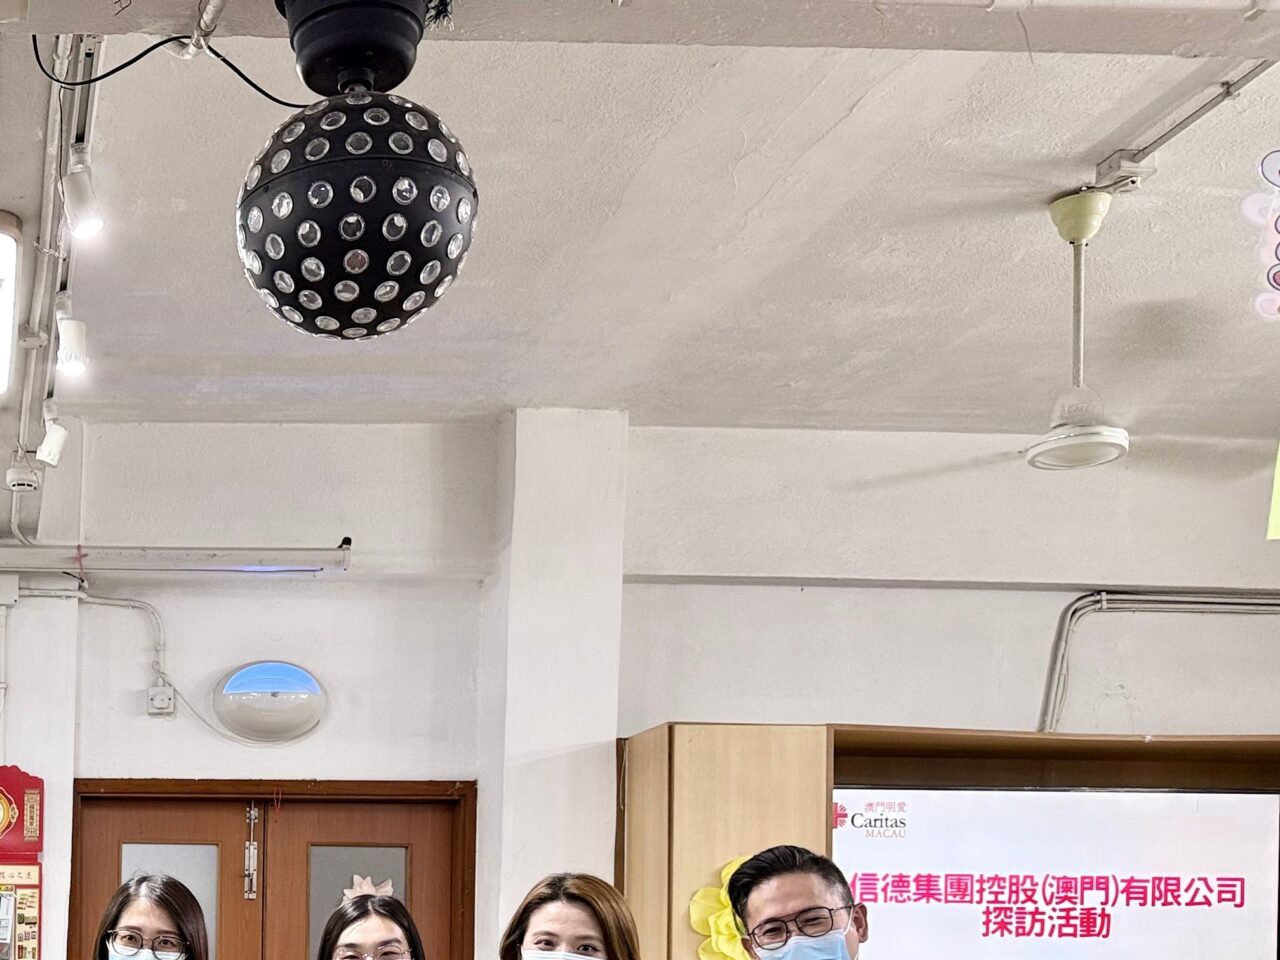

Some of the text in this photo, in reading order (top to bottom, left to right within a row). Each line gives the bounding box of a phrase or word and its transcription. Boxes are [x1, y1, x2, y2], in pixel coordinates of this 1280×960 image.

[864, 801, 907, 813] 澳門明愛
[850, 812, 907, 829] Caritas
[865, 829, 906, 838] MACAU
[851, 872, 1245, 908] 信德集團控股(澳門)有限公司
[981, 906, 1112, 938] 探訪活動
